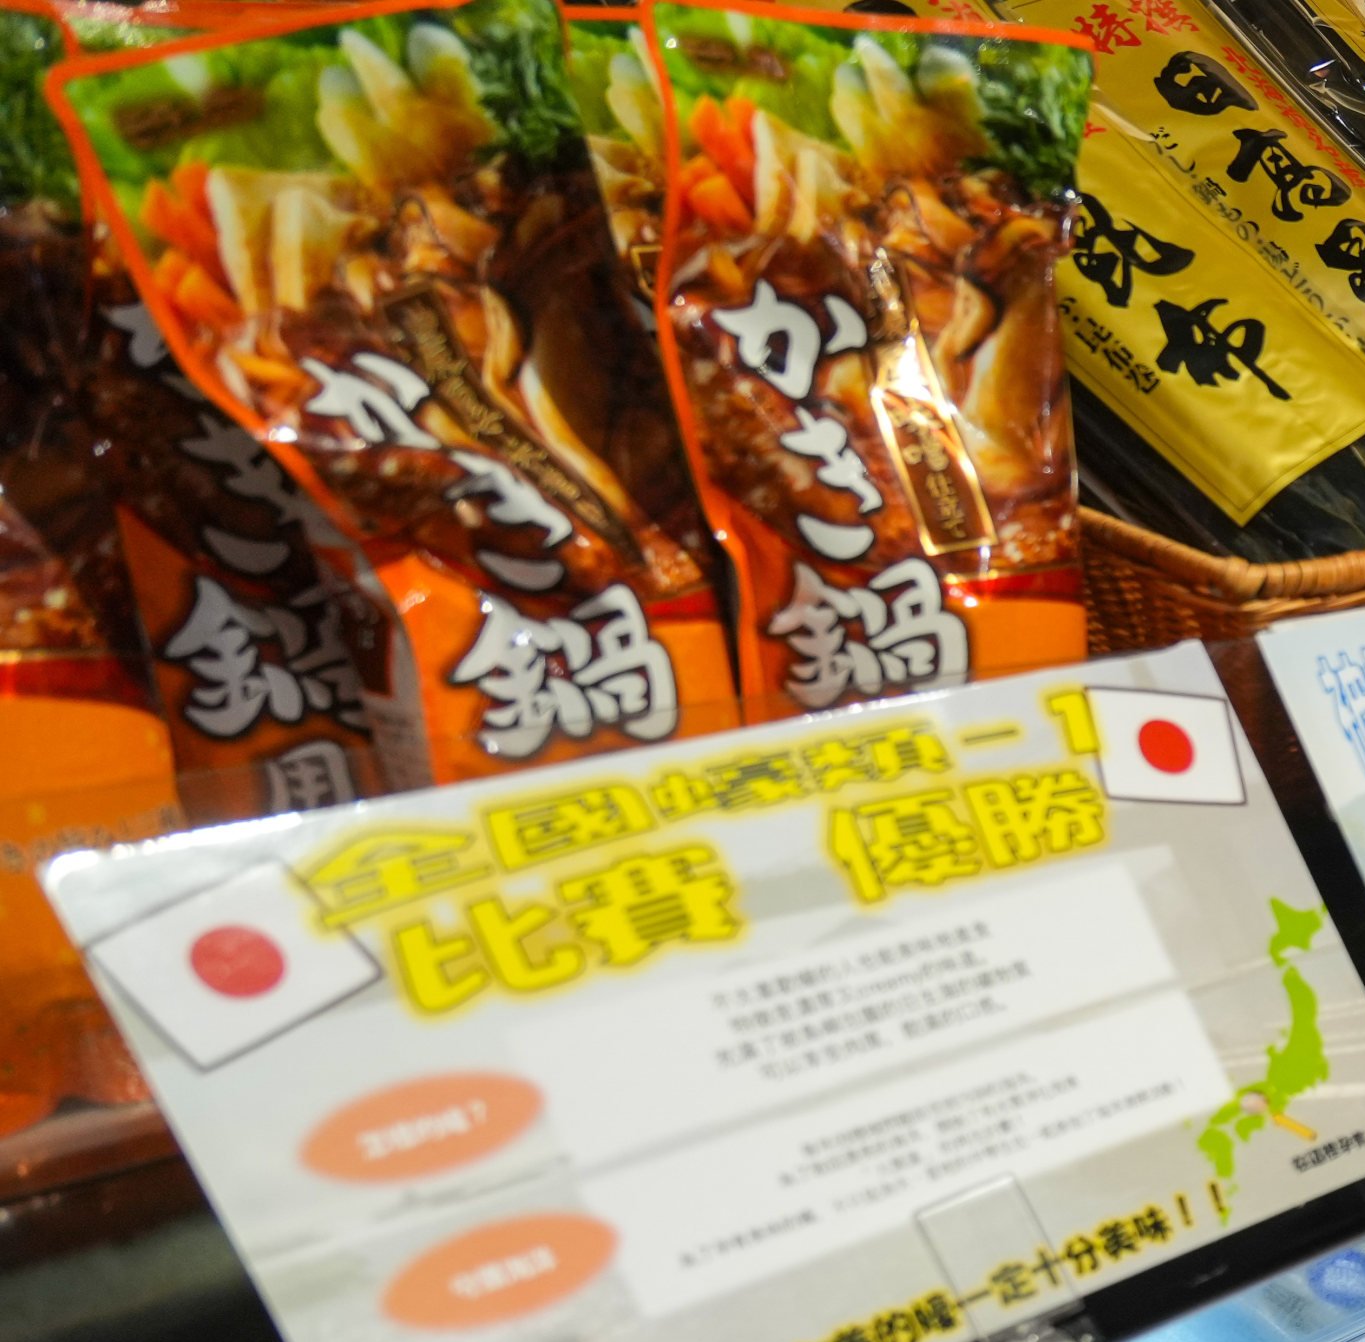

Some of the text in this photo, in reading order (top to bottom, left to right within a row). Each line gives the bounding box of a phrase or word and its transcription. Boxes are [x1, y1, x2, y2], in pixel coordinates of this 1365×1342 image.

[302, 352, 678, 760] かき鍋
[711, 277, 970, 709] かき鍋
[397, 772, 1106, 1012] 比賽 優勝
